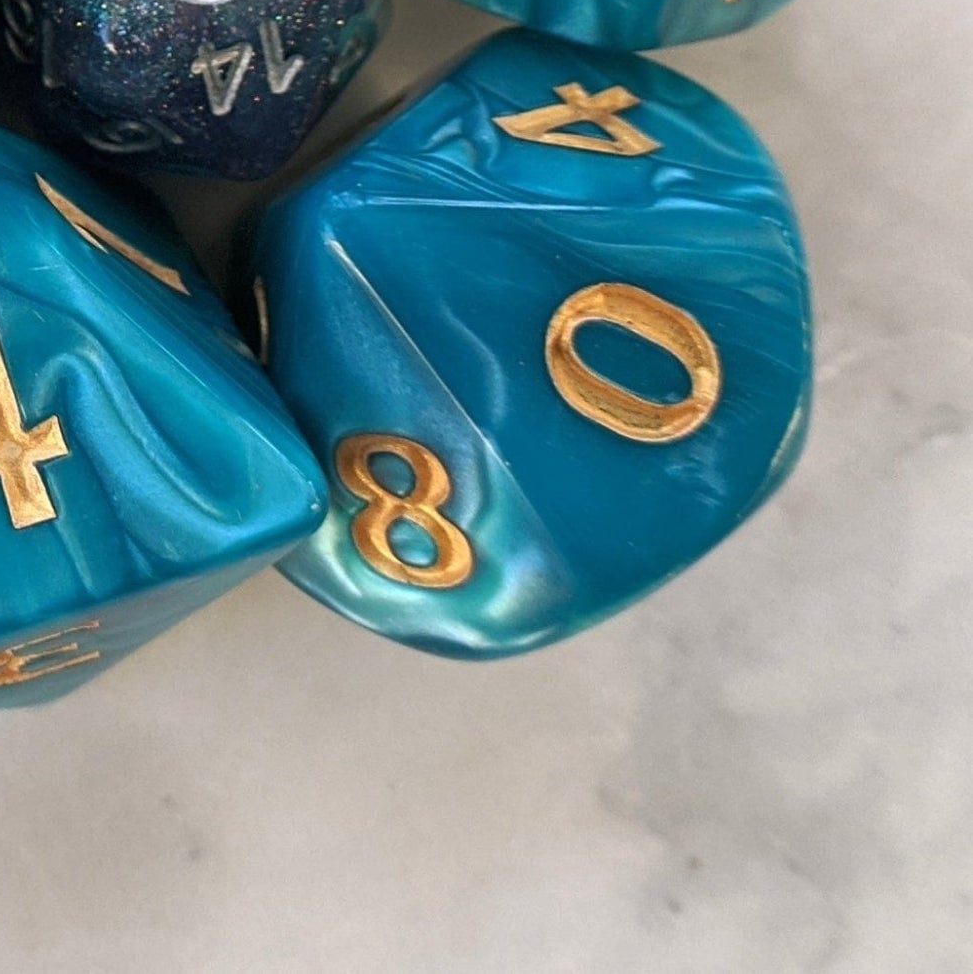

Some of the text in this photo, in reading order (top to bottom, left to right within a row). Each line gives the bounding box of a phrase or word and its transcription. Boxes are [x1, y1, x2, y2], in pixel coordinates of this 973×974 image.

[190, 20, 304, 117] 14
[493, 82, 662, 158] 4
[544, 282, 722, 444] 0
[335, 433, 475, 589] 8
